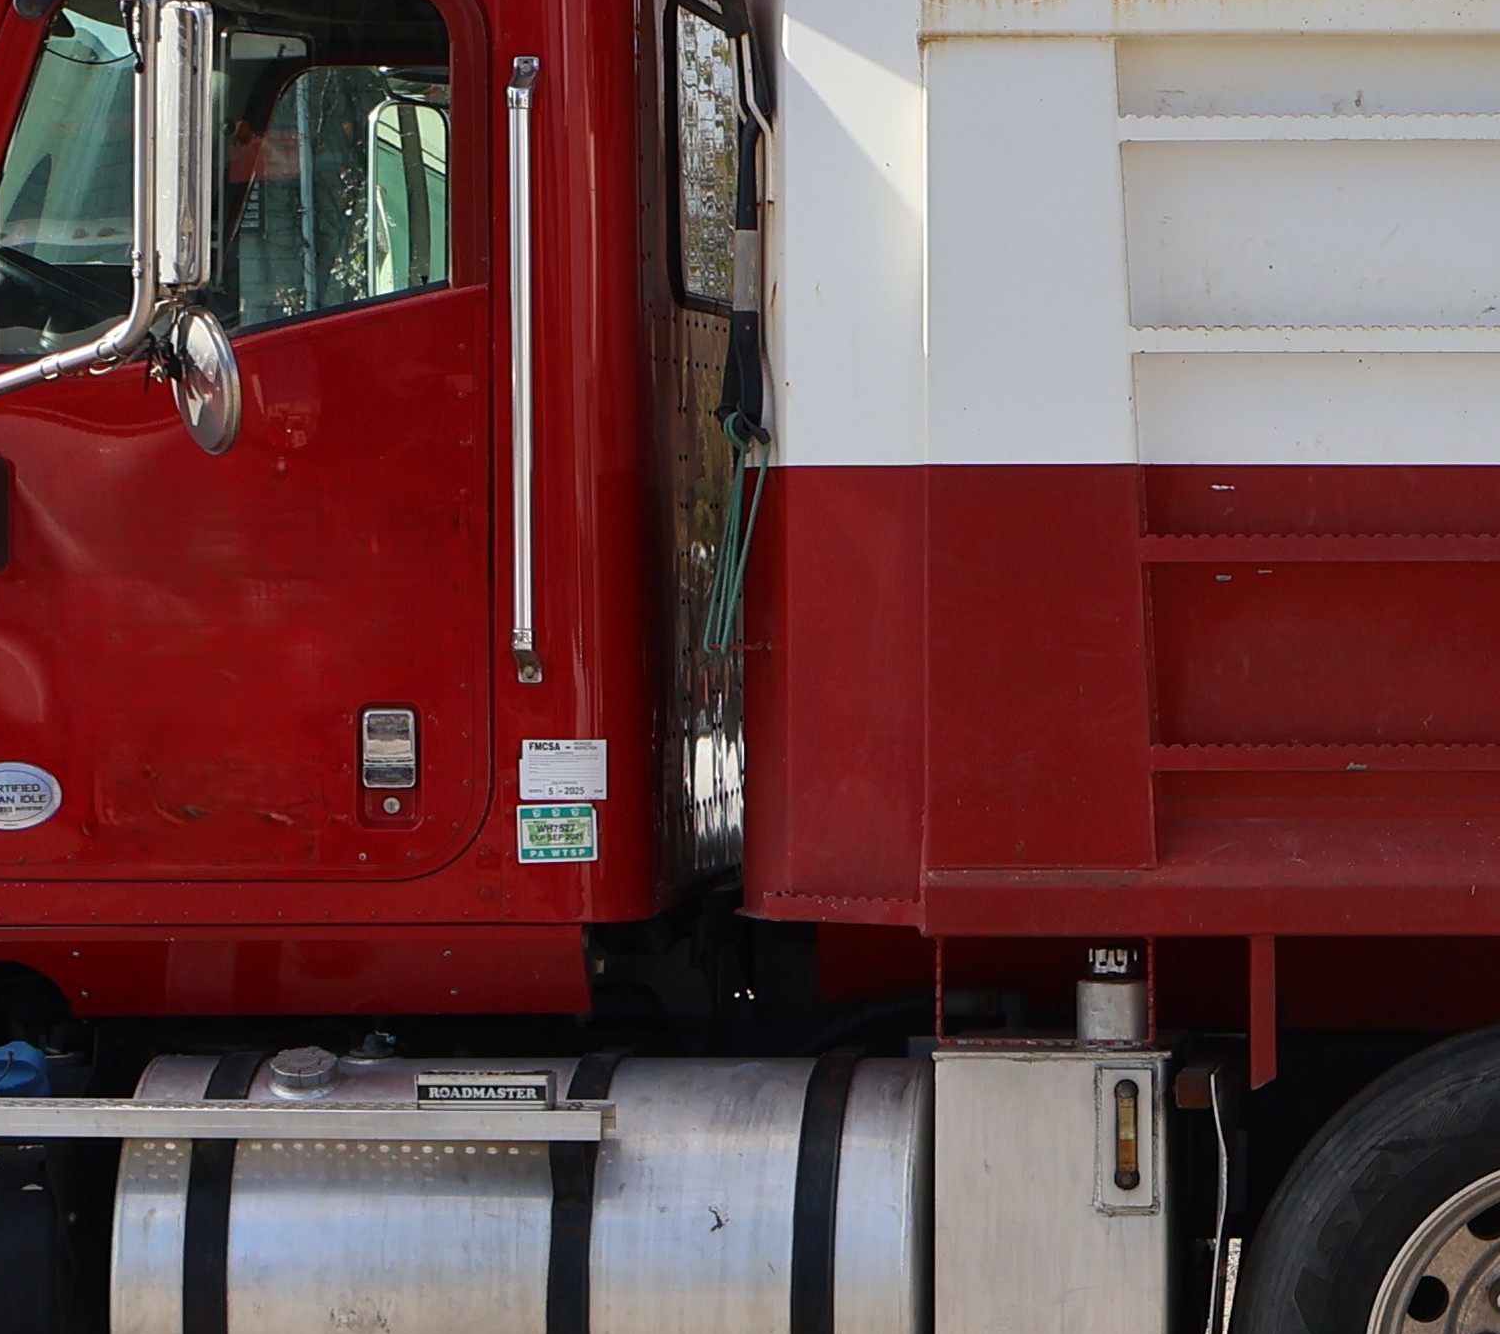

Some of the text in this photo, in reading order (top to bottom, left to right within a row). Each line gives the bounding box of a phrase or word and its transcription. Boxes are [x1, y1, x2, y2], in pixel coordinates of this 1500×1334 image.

[529, 742, 560, 751] FMCSA
[548, 787, 554, 795] 5
[564, 787, 585, 795] 2025
[20, 794, 47, 804] IDLE
[547, 833, 564, 841] SEP
[551, 849, 586, 857] WTSP
[428, 1087, 538, 1099] ROADMASTER
